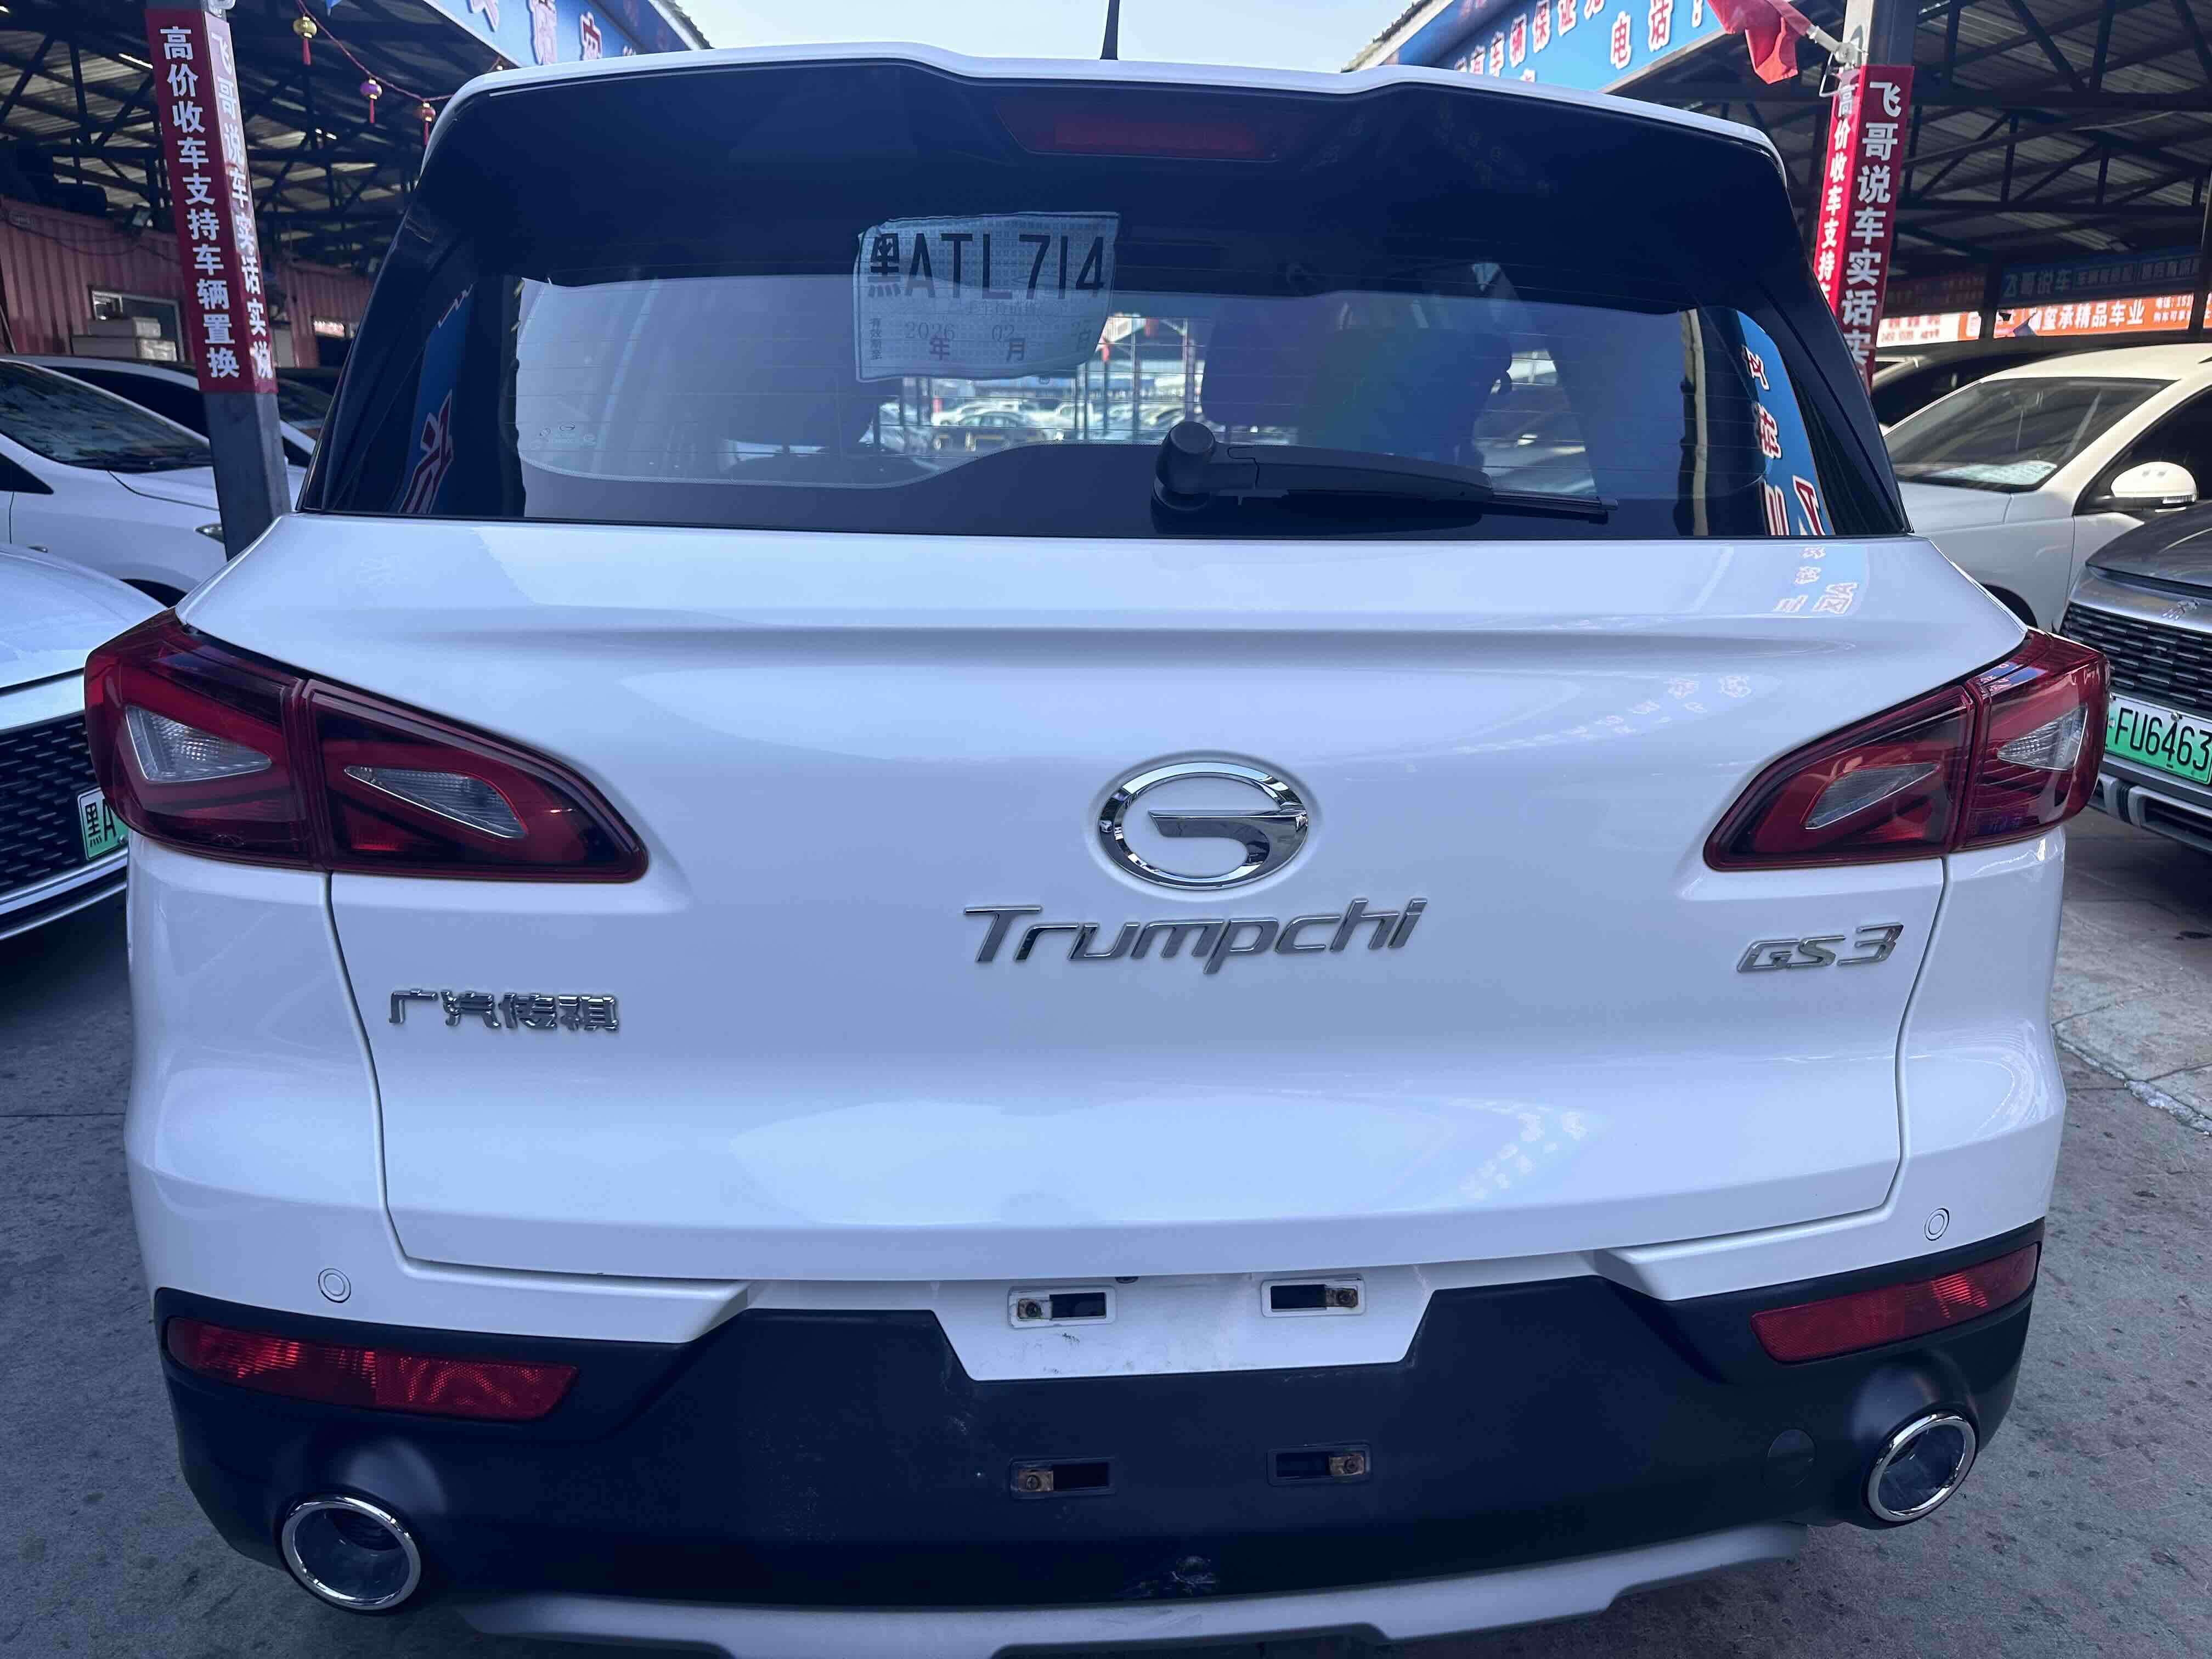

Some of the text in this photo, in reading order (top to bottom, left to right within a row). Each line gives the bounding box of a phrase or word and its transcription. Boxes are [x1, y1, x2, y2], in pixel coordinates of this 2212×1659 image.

[160, 26, 240, 379] 高价收车支持车辆置换
[211, 31, 273, 379] 飞哥说车实话实说
[1841, 81, 1902, 380] 飞哥说车实话实
[867, 233, 1105, 300] 黑ATL714
[929, 337, 950, 360] 年
[1006, 337, 1026, 362] 月
[2115, 707, 2212, 771] FU6463
[85, 798, 117, 847] 黑A
[964, 898, 1427, 975] Trumpchi
[1736, 922, 1904, 973] GS3
[388, 988, 619, 1031] 广汽传祺
